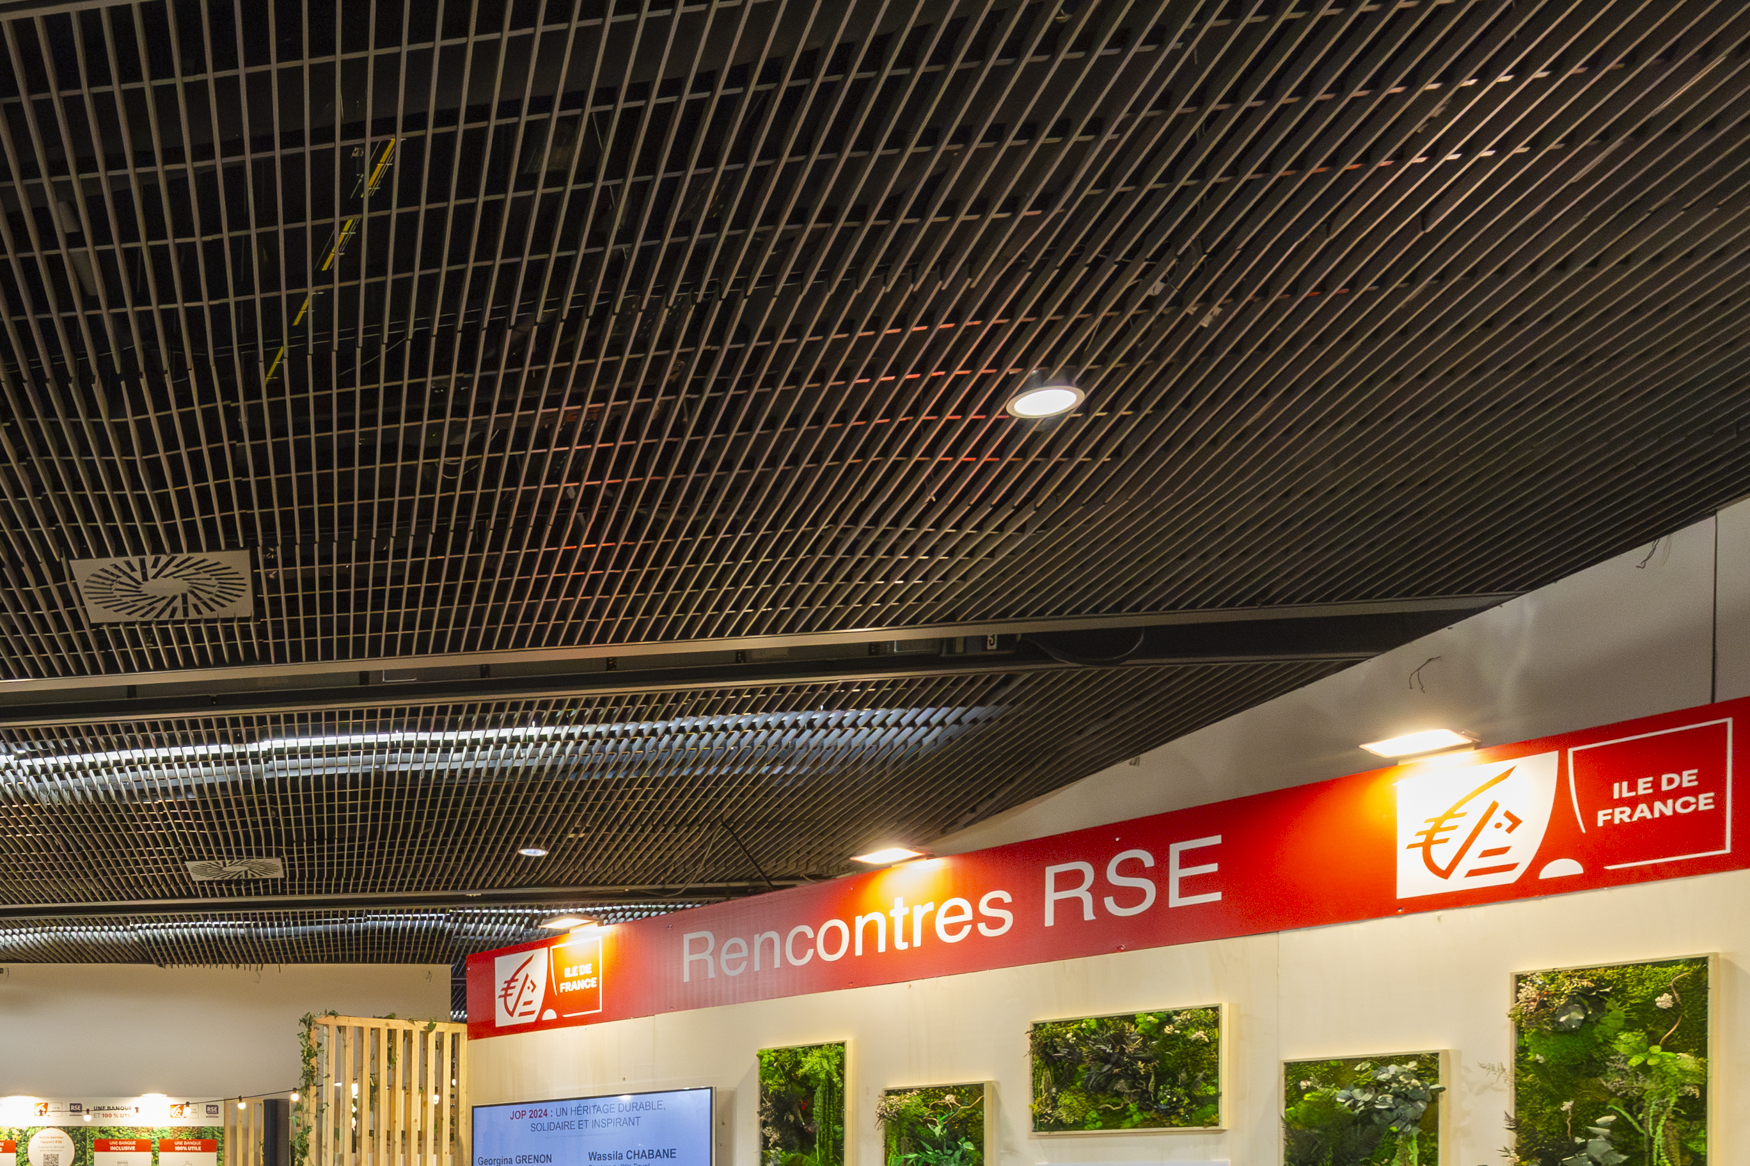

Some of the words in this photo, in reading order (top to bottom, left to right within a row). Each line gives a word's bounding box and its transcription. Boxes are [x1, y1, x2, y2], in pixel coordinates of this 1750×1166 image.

[1612, 776, 1653, 800] ILE
[1661, 768, 1699, 792] DE
[1597, 792, 1716, 827] FRANCE
[682, 889, 1014, 983] Rencontres
[1044, 834, 1223, 928] RSE
[564, 966, 578, 979] ILE
[579, 963, 592, 976] DE
[559, 977, 598, 993] FRANCE
[510, 1110, 527, 1120] JOP
[529, 1108, 548, 1119] 2024
[555, 1107, 568, 1117] UN
[570, 1103, 615, 1116] HÉRITAGE
[618, 1099, 666, 1113] DURABLE,
[530, 1120, 576, 1132] SOLIDAIRE
[578, 1119, 589, 1130] ET
[591, 1116, 641, 1129] INSPIRANT
[477, 1156, 513, 1166] Georgina
[515, 1154, 552, 1164] GRENON
[588, 1151, 623, 1161] Wassila
[626, 1148, 677, 1160] CHABANE
